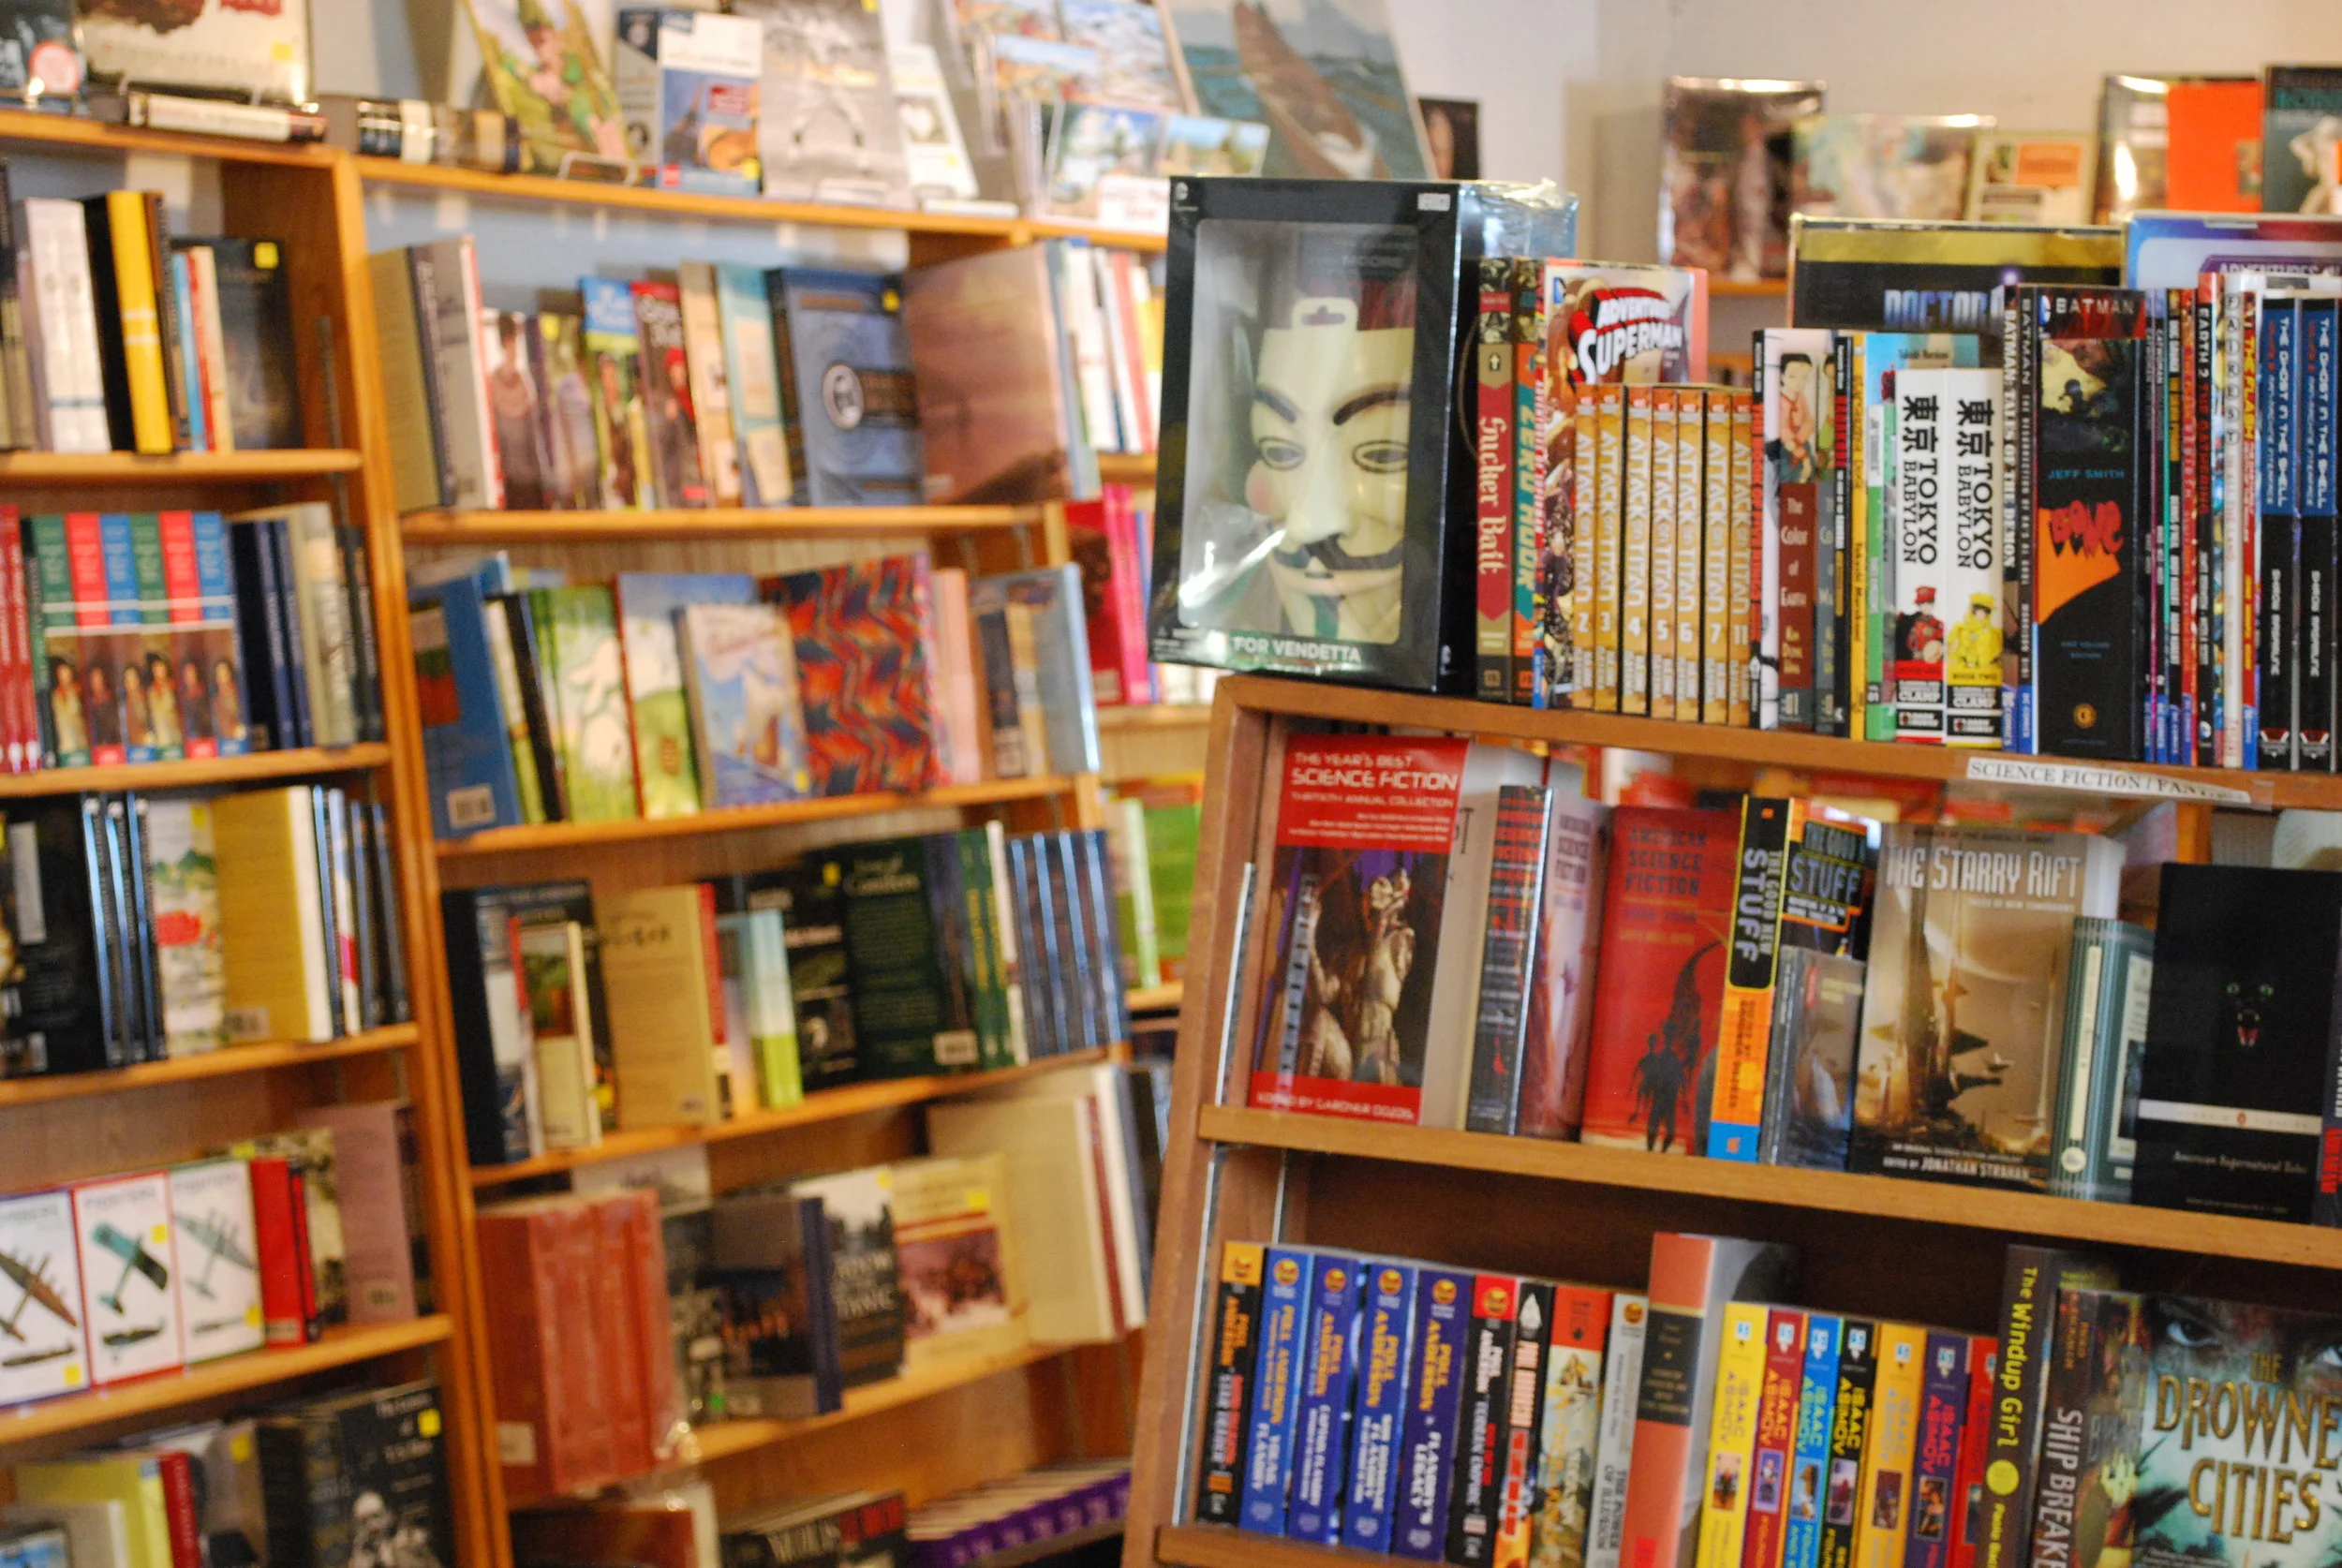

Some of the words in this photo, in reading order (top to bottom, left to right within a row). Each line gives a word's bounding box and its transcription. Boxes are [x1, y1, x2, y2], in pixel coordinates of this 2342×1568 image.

[2054, 298, 2134, 315] BATMAN
[2199, 307, 2210, 363] EARTH
[2278, 318, 2290, 348] THE
[2318, 318, 2330, 348] THE
[1578, 322, 1683, 385] SUPERMAN
[2004, 310, 2018, 386] BATMAN:
[2022, 299, 2032, 386] BATMAN
[2156, 328, 2165, 384] CATWOMAN
[2244, 337, 2256, 373] THE
[2199, 368, 2209, 379] 2
[2278, 351, 2290, 401] GHOST
[2318, 352, 2330, 402] GHOST
[1902, 395, 1940, 453] 東京
[1956, 399, 1994, 458] 東京
[2004, 388, 2017, 442] TALES
[2244, 376, 2256, 440] FLASH
[1479, 417, 1507, 505] Sucker
[2004, 445, 2017, 466] OF
[2278, 424, 2290, 453] THE
[2318, 426, 2330, 455] THE
[1577, 431, 1595, 517] ATTACK
[1599, 431, 1619, 517] ATTACK
[1627, 434, 1649, 521] ATTACK
[1653, 436, 1674, 524] ATTACK
[1678, 438, 1697, 524] ATTACK
[1706, 439, 1727, 525] ATTACK
[1734, 439, 1752, 525] ATTACK
[2004, 469, 2017, 505] THE
[2048, 470, 2081, 479] JEFF
[2084, 470, 2126, 479] SMITH
[2278, 458, 2290, 509] SHELL
[2318, 460, 2330, 510] SHELL
[1904, 461, 1917, 564] BABYLON
[1918, 459, 1938, 565] TOKYO
[1957, 466, 1972, 569] BABYLON
[1973, 465, 1994, 570] TOKYO
[2003, 507, 2017, 569] DEMON
[2049, 499, 2125, 558] BONE
[1479, 516, 1507, 576] Bait
[1577, 537, 1596, 602] TITAN
[1599, 538, 1619, 601] TITAN
[1627, 542, 1649, 607] TITAN
[1653, 546, 1674, 610] TITAN
[1678, 547, 1697, 614] TITAN
[1706, 548, 1727, 614] TITAN
[1734, 549, 1752, 615] TITAN
[1273, 639, 1362, 663] VENDETTA
[1578, 612, 1590, 634] 2
[1600, 611, 1611, 632] 3
[1628, 616, 1641, 637] 4
[1655, 619, 1669, 641] 5
[1679, 622, 1694, 643] 6
[1709, 622, 1724, 644] 7
[1734, 624, 1749, 645] 11
[1290, 766, 1377, 789] SCIENCE
[1378, 771, 1459, 791] FICTION
[1294, 751, 1322, 765] THE
[1324, 753, 1374, 767] YEAR'S
[1376, 754, 1414, 769] BEST
[1970, 760, 2056, 783] SCIENCE
[2061, 765, 2141, 789] FICTION
[1624, 872, 1702, 895] FICTION
[1628, 849, 1704, 871] SCIENCE
[1789, 855, 1861, 904] STUFF
[1885, 844, 1926, 889] THE
[1931, 845, 2023, 895] STARRY
[2026, 850, 2083, 899] RIFT
[1734, 848, 1770, 963] STUFF
[2019, 1266, 2038, 1299] The
[1365, 1309, 1389, 1409] ANDERSON
[1418, 1318, 1444, 1412] ANDERSON
[2000, 1302, 2037, 1390] Windup
[2250, 1351, 2283, 1383] THE
[1758, 1367, 1781, 1447] ASIMOV
[1771, 1378, 1794, 1442] ISAAC
[1795, 1374, 1815, 1453] ASIMOV
[1807, 1385, 1828, 1447] ISAAC
[1831, 1376, 1853, 1457] ASIMOV
[1845, 1386, 1867, 1451] ISAAC
[1921, 1393, 1943, 1473] ASIMOV
[1936, 1404, 1958, 1468] ISAAC
[1996, 1397, 2023, 1448] Girl
[2045, 1406, 2083, 1470] SHIP
[2187, 1457, 2323, 1545] CITIES
